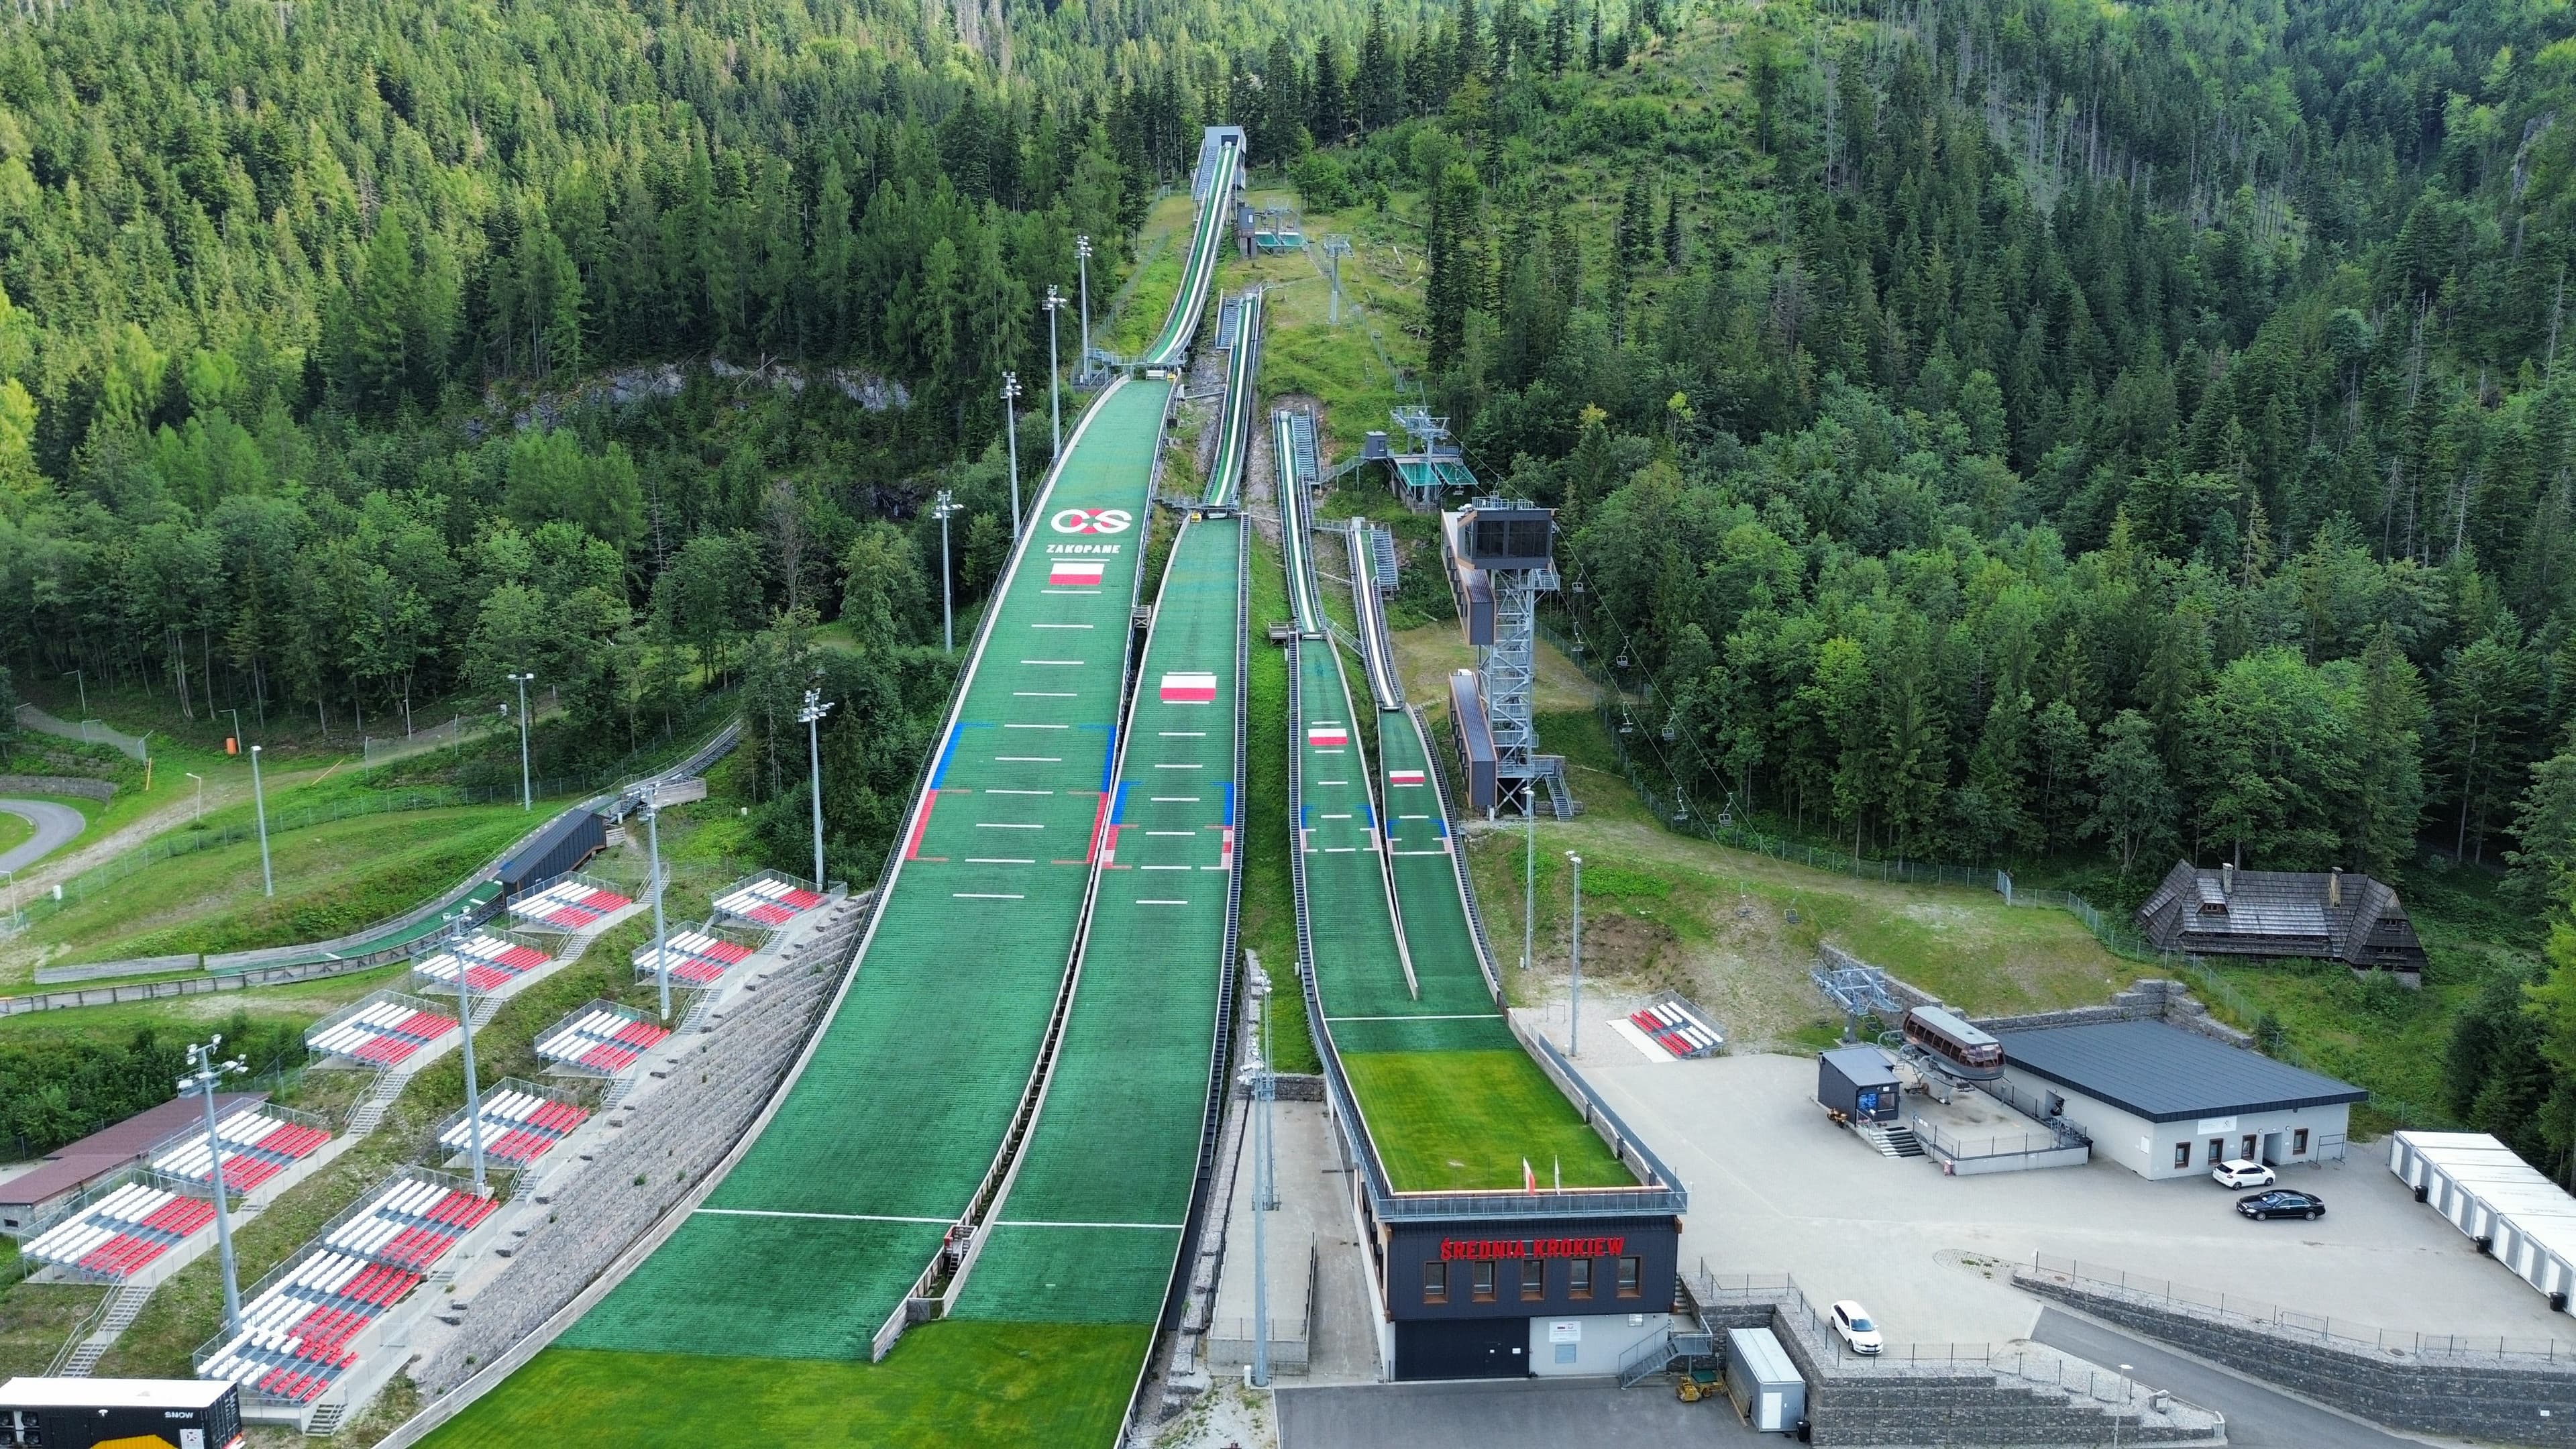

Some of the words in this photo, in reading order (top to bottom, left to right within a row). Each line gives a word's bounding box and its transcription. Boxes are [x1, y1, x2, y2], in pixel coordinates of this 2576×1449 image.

[1046, 544, 1121, 553] ZAKOPANE
[1440, 1238, 1525, 1260] ŚREDNIA
[1534, 1237, 1624, 1258] KROKIEW
[164, 1411, 193, 1419] SNOW
